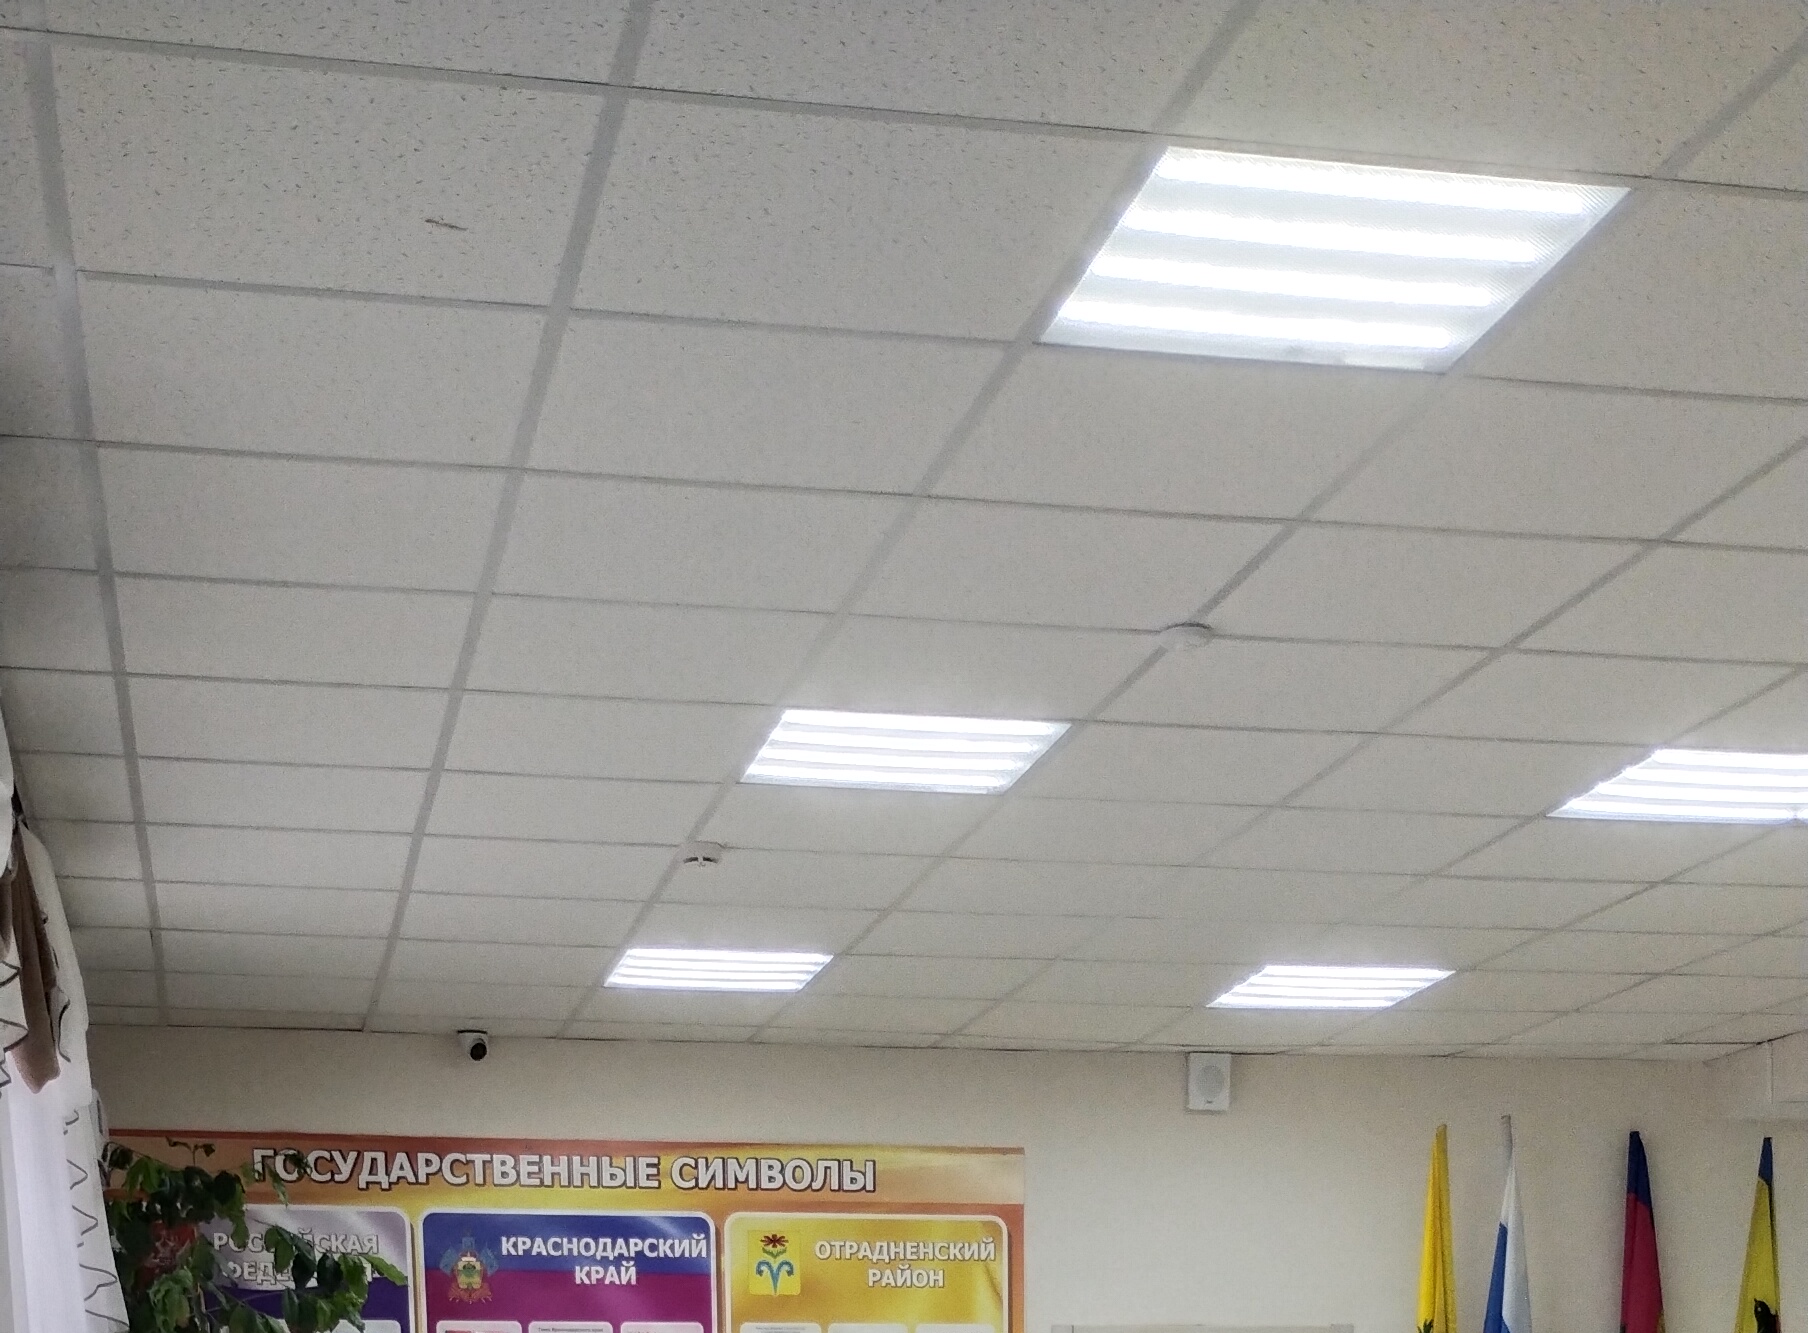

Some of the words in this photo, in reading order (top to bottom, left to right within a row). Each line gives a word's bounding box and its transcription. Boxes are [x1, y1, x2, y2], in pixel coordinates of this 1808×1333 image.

[252, 1147, 661, 1191] ГОСУДАРСТВЕННЫЕ
[670, 1157, 877, 1192] СИМВОЛЫ
[501, 1233, 708, 1260] КРАСНОДАРСКИЙ
[814, 1236, 996, 1264] ОТРАДНЕНСКИЙ
[575, 1260, 637, 1286] КРАЙ
[868, 1264, 945, 1288] РАЙОН
